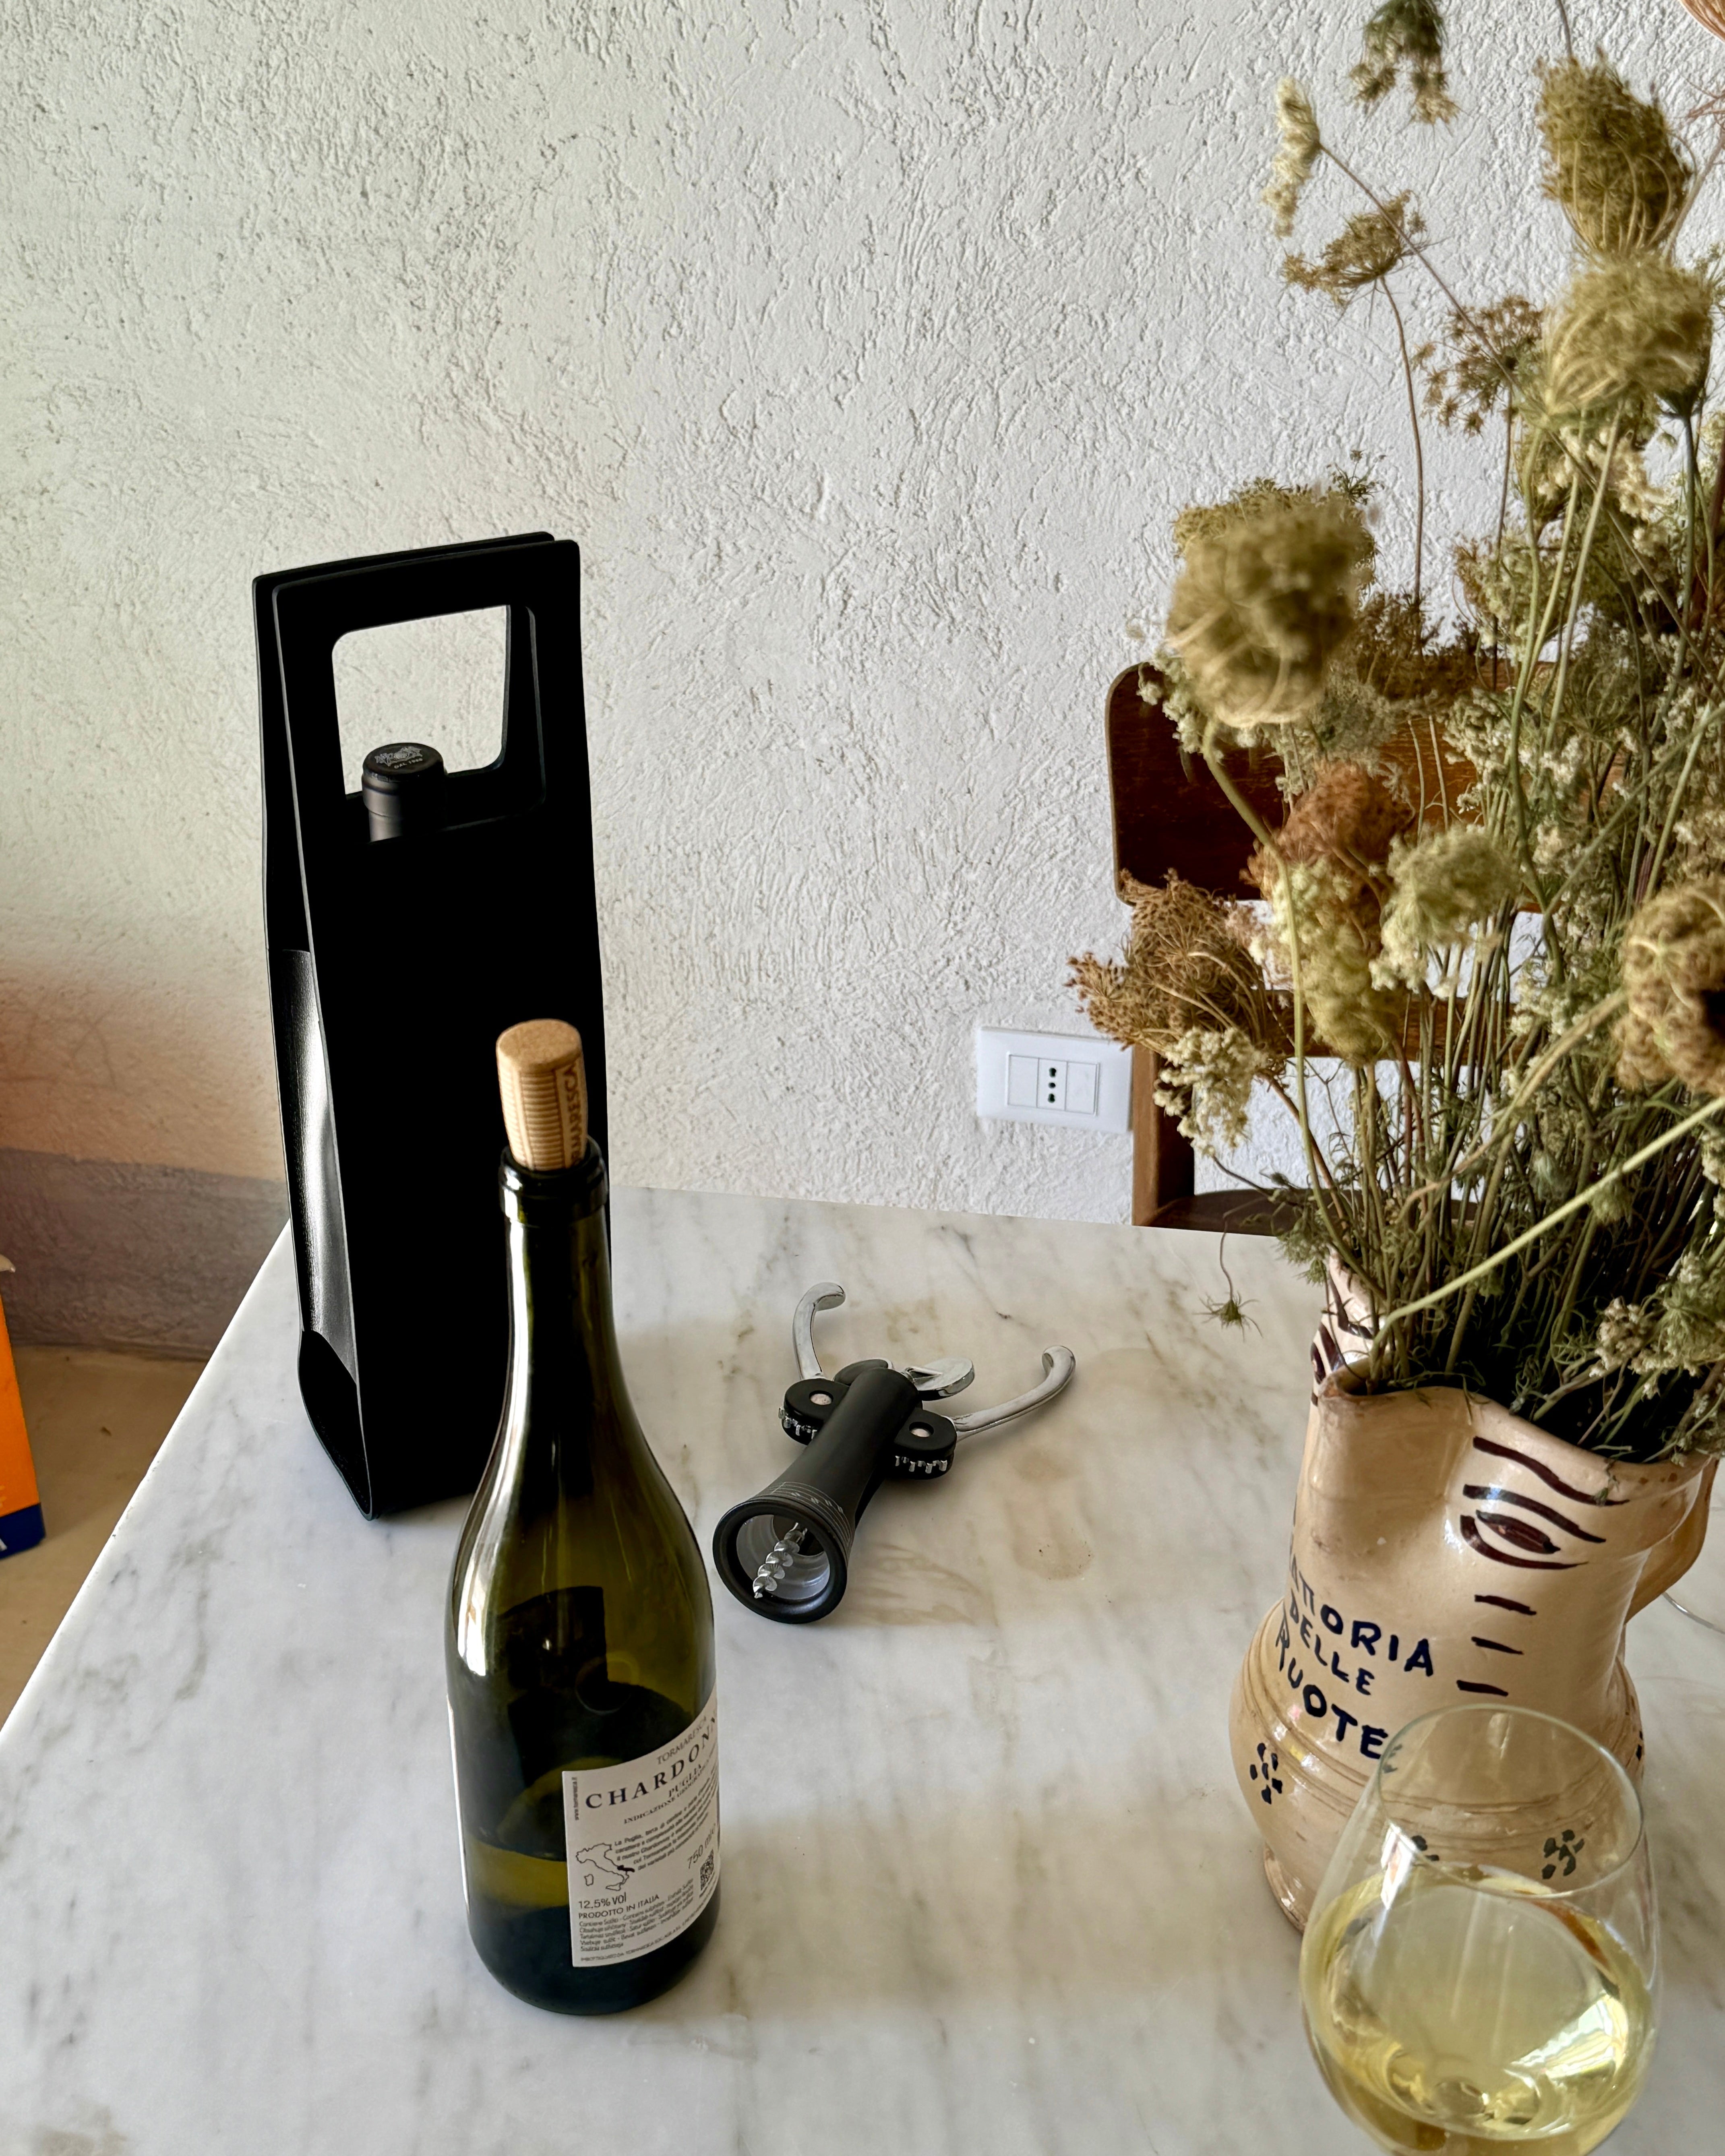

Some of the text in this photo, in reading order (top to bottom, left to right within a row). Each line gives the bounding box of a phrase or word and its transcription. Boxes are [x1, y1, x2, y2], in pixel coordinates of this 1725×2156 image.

[1289, 1588, 1375, 1696] DELLE
[1275, 1602, 1388, 1759] RUOTE
[668, 1764, 701, 1798] PUGLIA
[624, 1796, 676, 1824] INDICAZIONE
[687, 1844, 703, 1870] 750
[578, 1898, 611, 1909] 12.5%
[578, 1907, 624, 1919] PRODOTTO
[626, 1904, 635, 1912] IN
[638, 1893, 660, 1908] ITALIA
